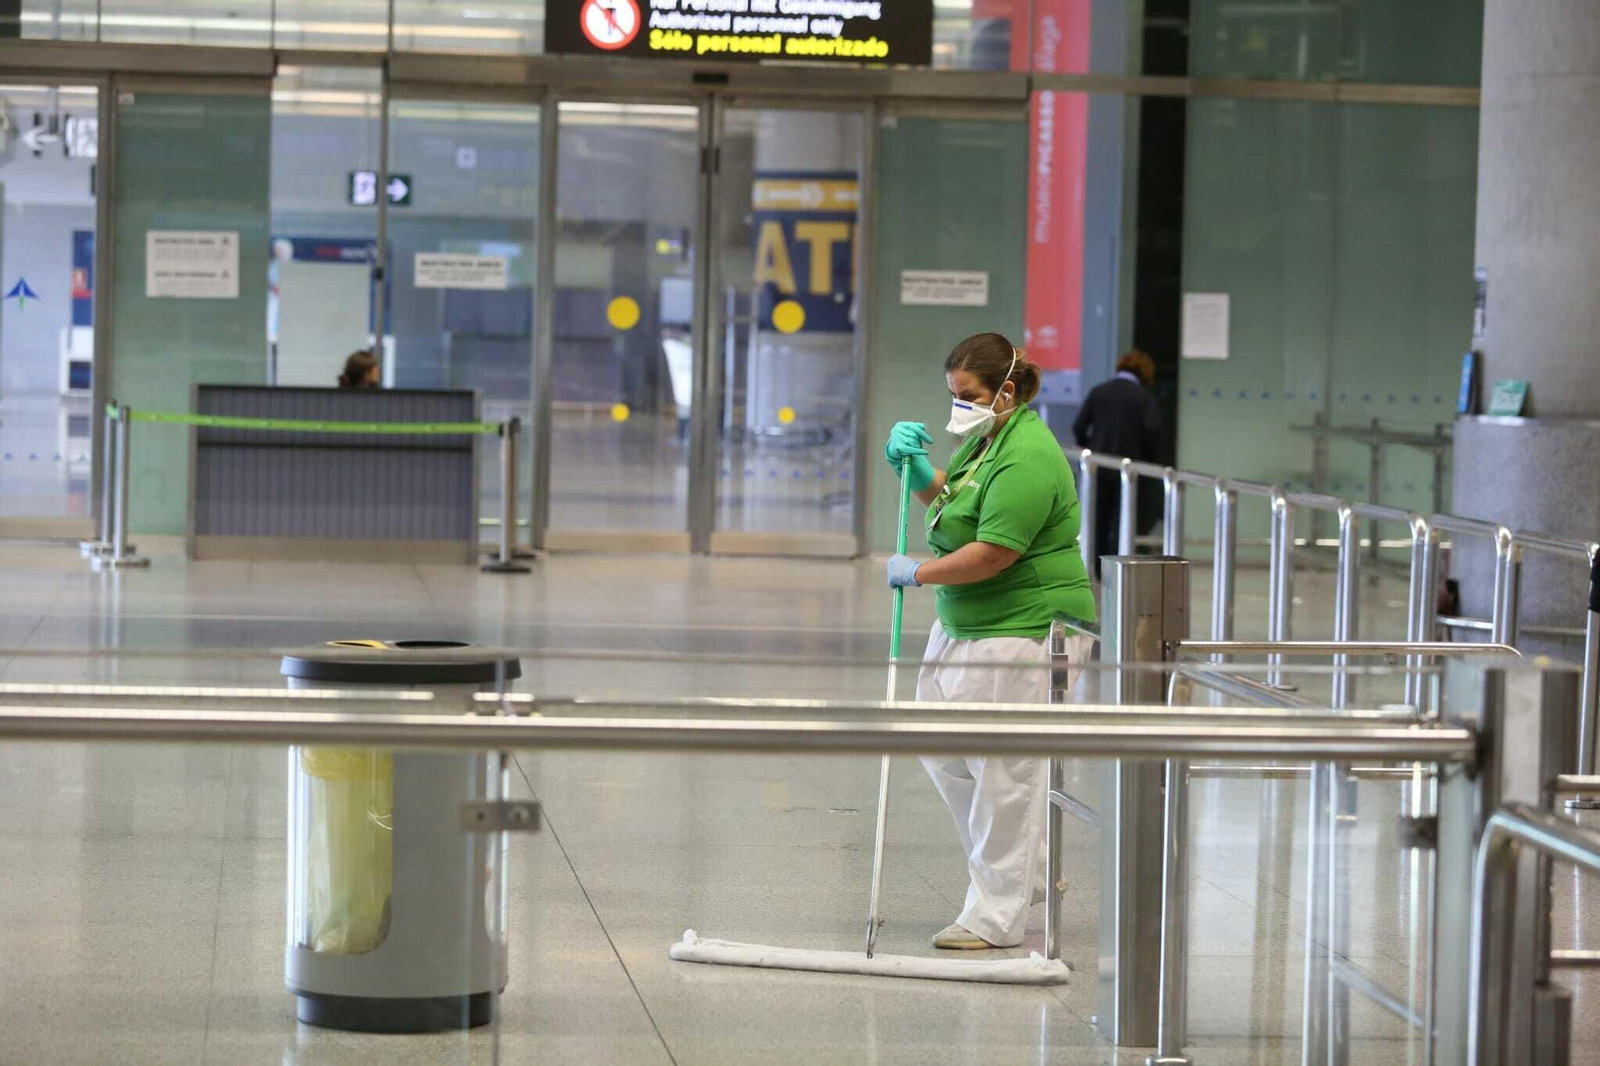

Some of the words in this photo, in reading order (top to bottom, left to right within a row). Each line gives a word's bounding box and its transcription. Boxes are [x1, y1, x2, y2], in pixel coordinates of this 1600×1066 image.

[649, 10, 731, 30] Authorized
[733, 15, 808, 33] personnel
[810, 16, 844, 37] only
[649, 28, 693, 51] Sólo
[697, 33, 781, 55] personal
[785, 35, 888, 57] autorizado
